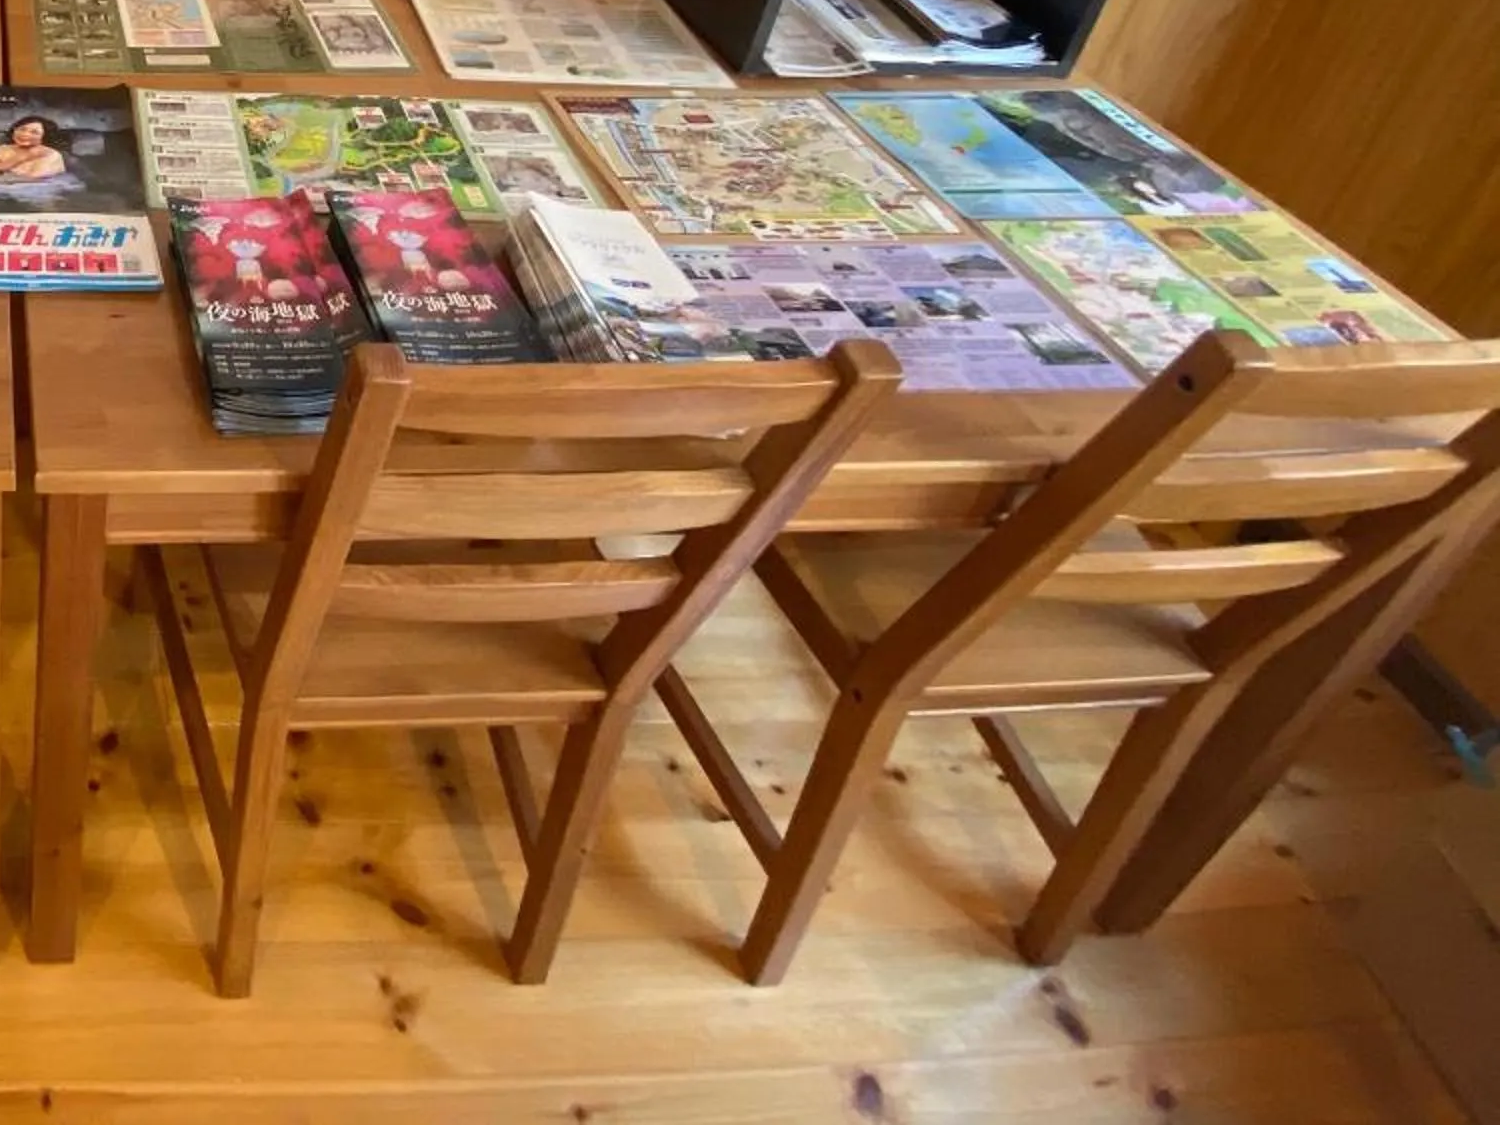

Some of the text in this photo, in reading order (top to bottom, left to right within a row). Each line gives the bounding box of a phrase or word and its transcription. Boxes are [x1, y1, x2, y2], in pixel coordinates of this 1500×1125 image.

[206, 300, 321, 323] 夜の海地獄
[382, 290, 498, 314] 夜の海地獄
